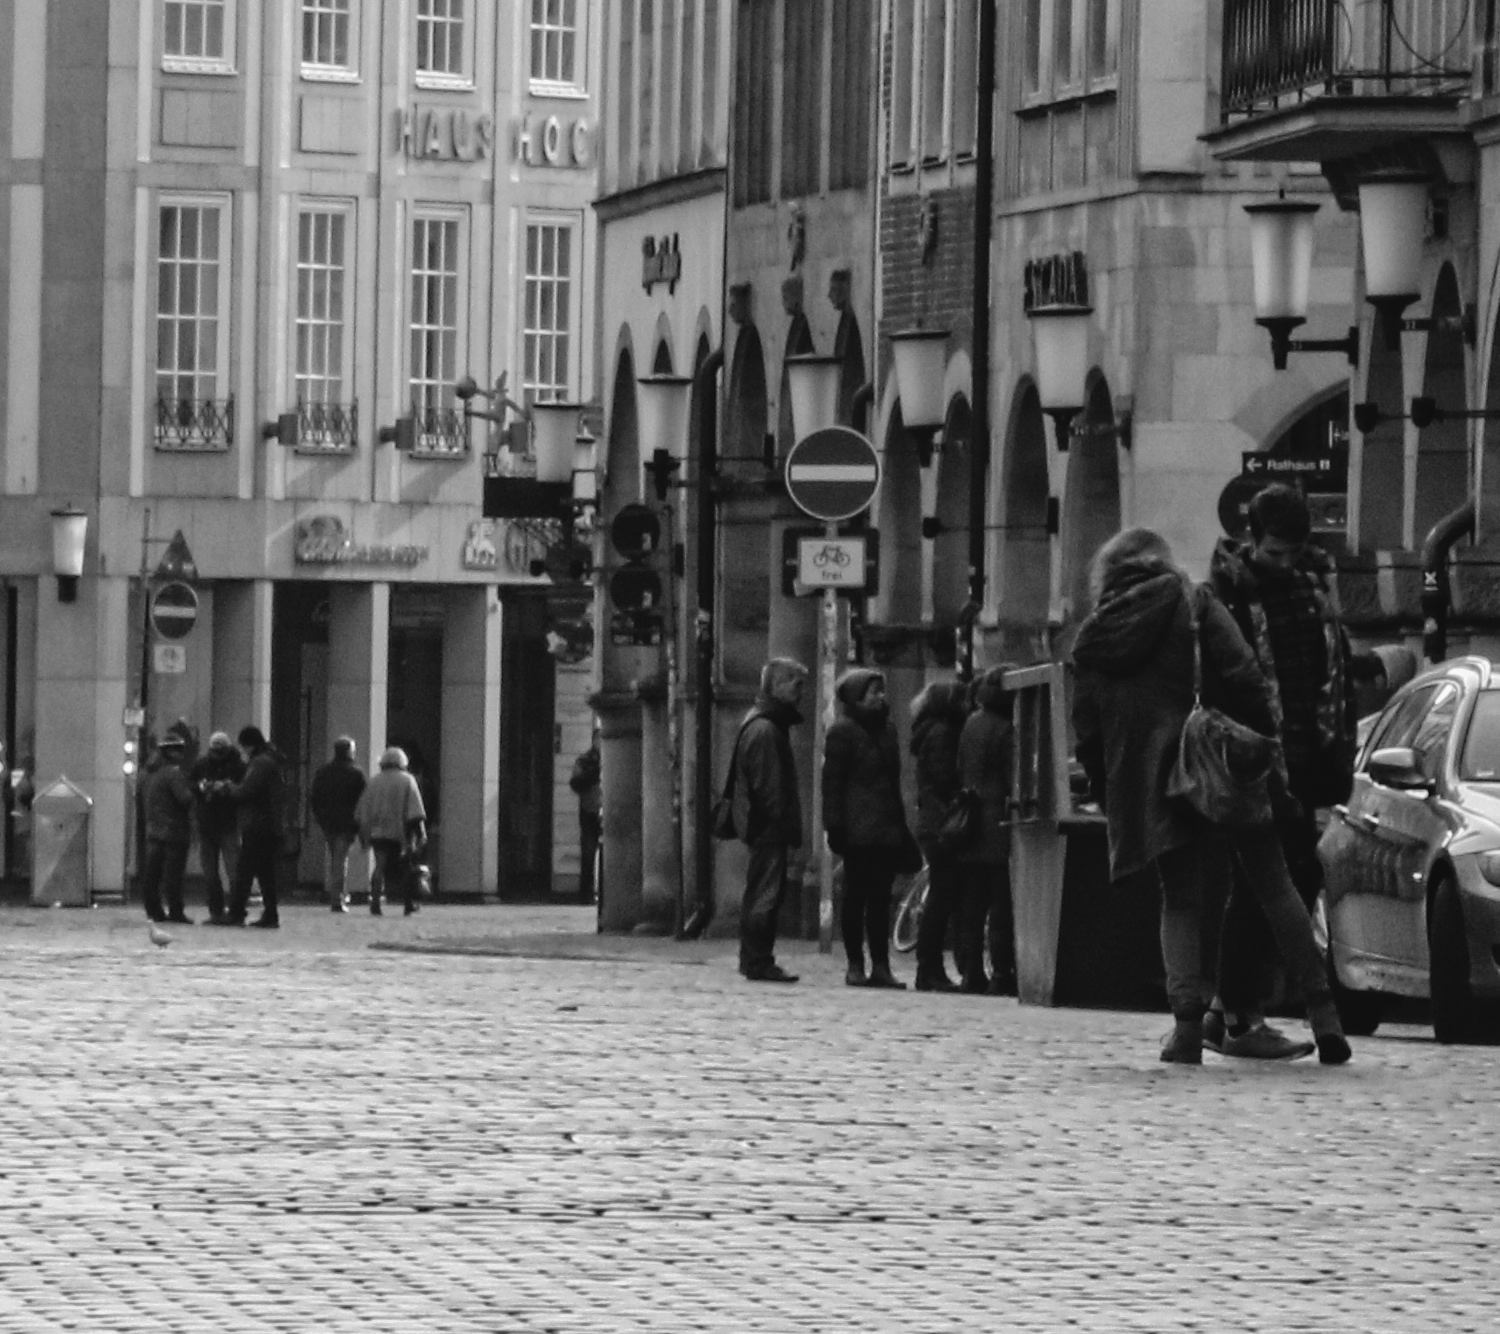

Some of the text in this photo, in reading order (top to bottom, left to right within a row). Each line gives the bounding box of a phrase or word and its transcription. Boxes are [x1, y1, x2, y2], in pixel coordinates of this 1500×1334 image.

[392, 108, 595, 169] HAUS HOC
[1266, 458, 1317, 471] Rathaus
